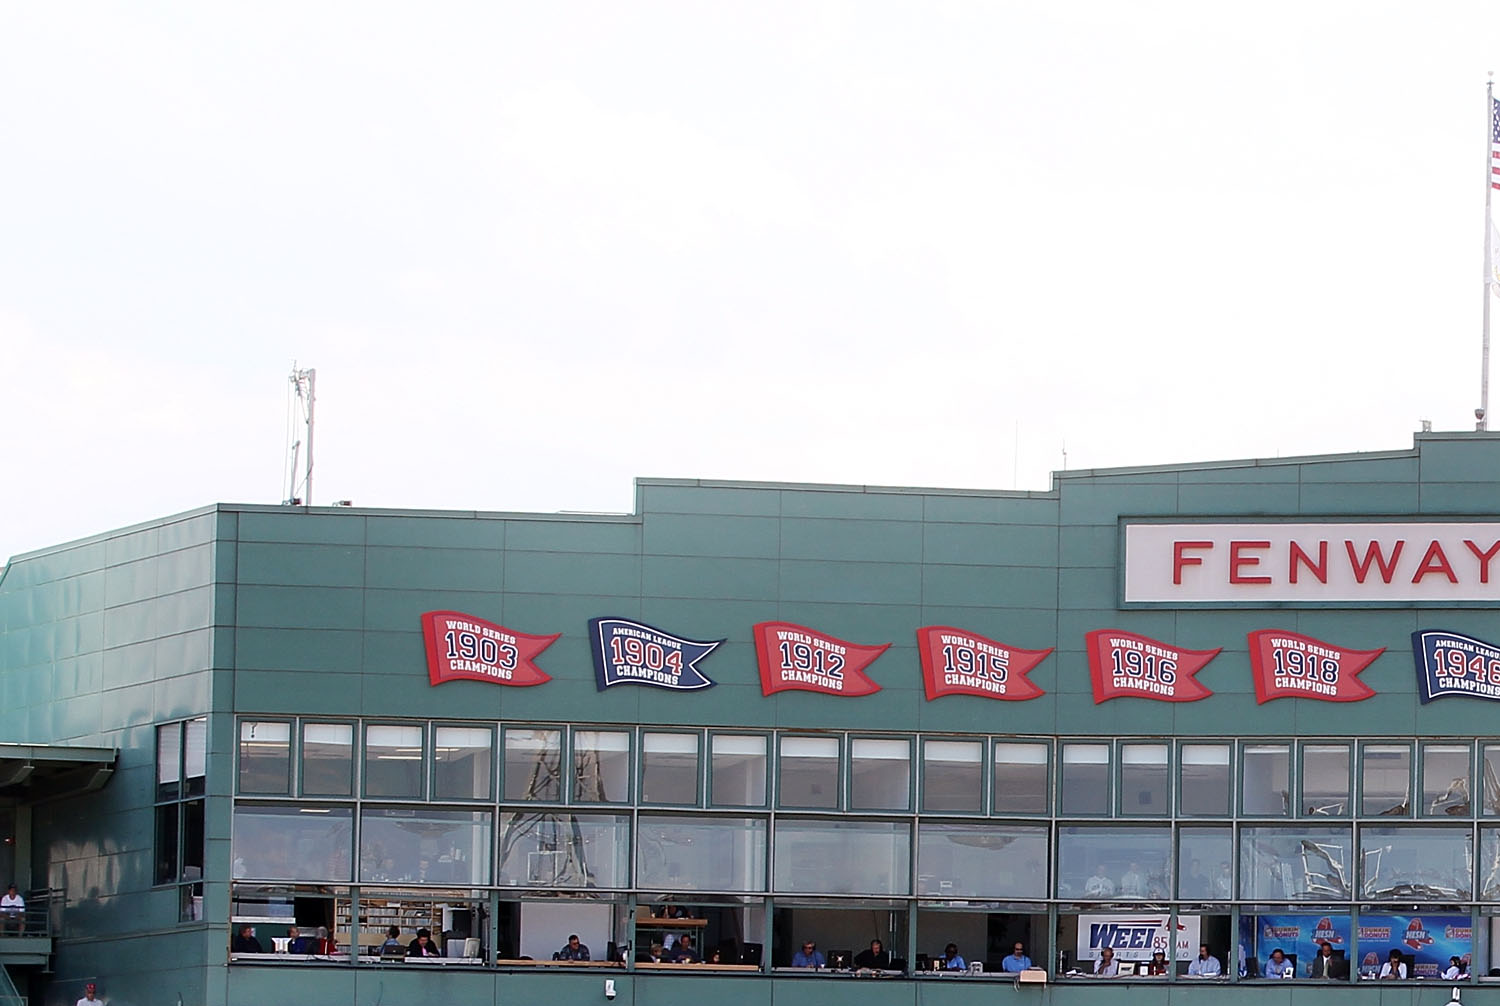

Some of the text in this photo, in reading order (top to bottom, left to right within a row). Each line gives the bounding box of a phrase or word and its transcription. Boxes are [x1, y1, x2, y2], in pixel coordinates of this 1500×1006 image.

[445, 620, 516, 645] WORLD SERIES
[612, 627, 682, 650] AMERICAN LEAGUE
[776, 631, 846, 655] WORLD SERIES
[444, 630, 519, 670] 1903
[610, 636, 683, 676] 1904
[941, 635, 1010, 659] WORLD SERIES
[1109, 638, 1178, 661] WORLD SERIES
[1270, 638, 1340, 660] WORLD SERIES
[1435, 639, 1474, 652] AMERICAN
[450, 659, 513, 680] CHAMPIONS
[779, 641, 845, 680] 1912
[942, 645, 1009, 683] 1915
[1111, 648, 1177, 685] 1916
[1272, 648, 1339, 685] 1918
[616, 664, 679, 685] CHAMPIONS
[781, 670, 843, 690] CHAMPIONS
[944, 674, 1006, 694] CHAMPIONS
[1113, 677, 1175, 696] CHAMPIONS
[1275, 677, 1337, 696] CHAMPIONS
[1089, 923, 1156, 949] WEEI
[1315, 930, 1335, 938] NESN
[1405, 931, 1426, 939] NESN
